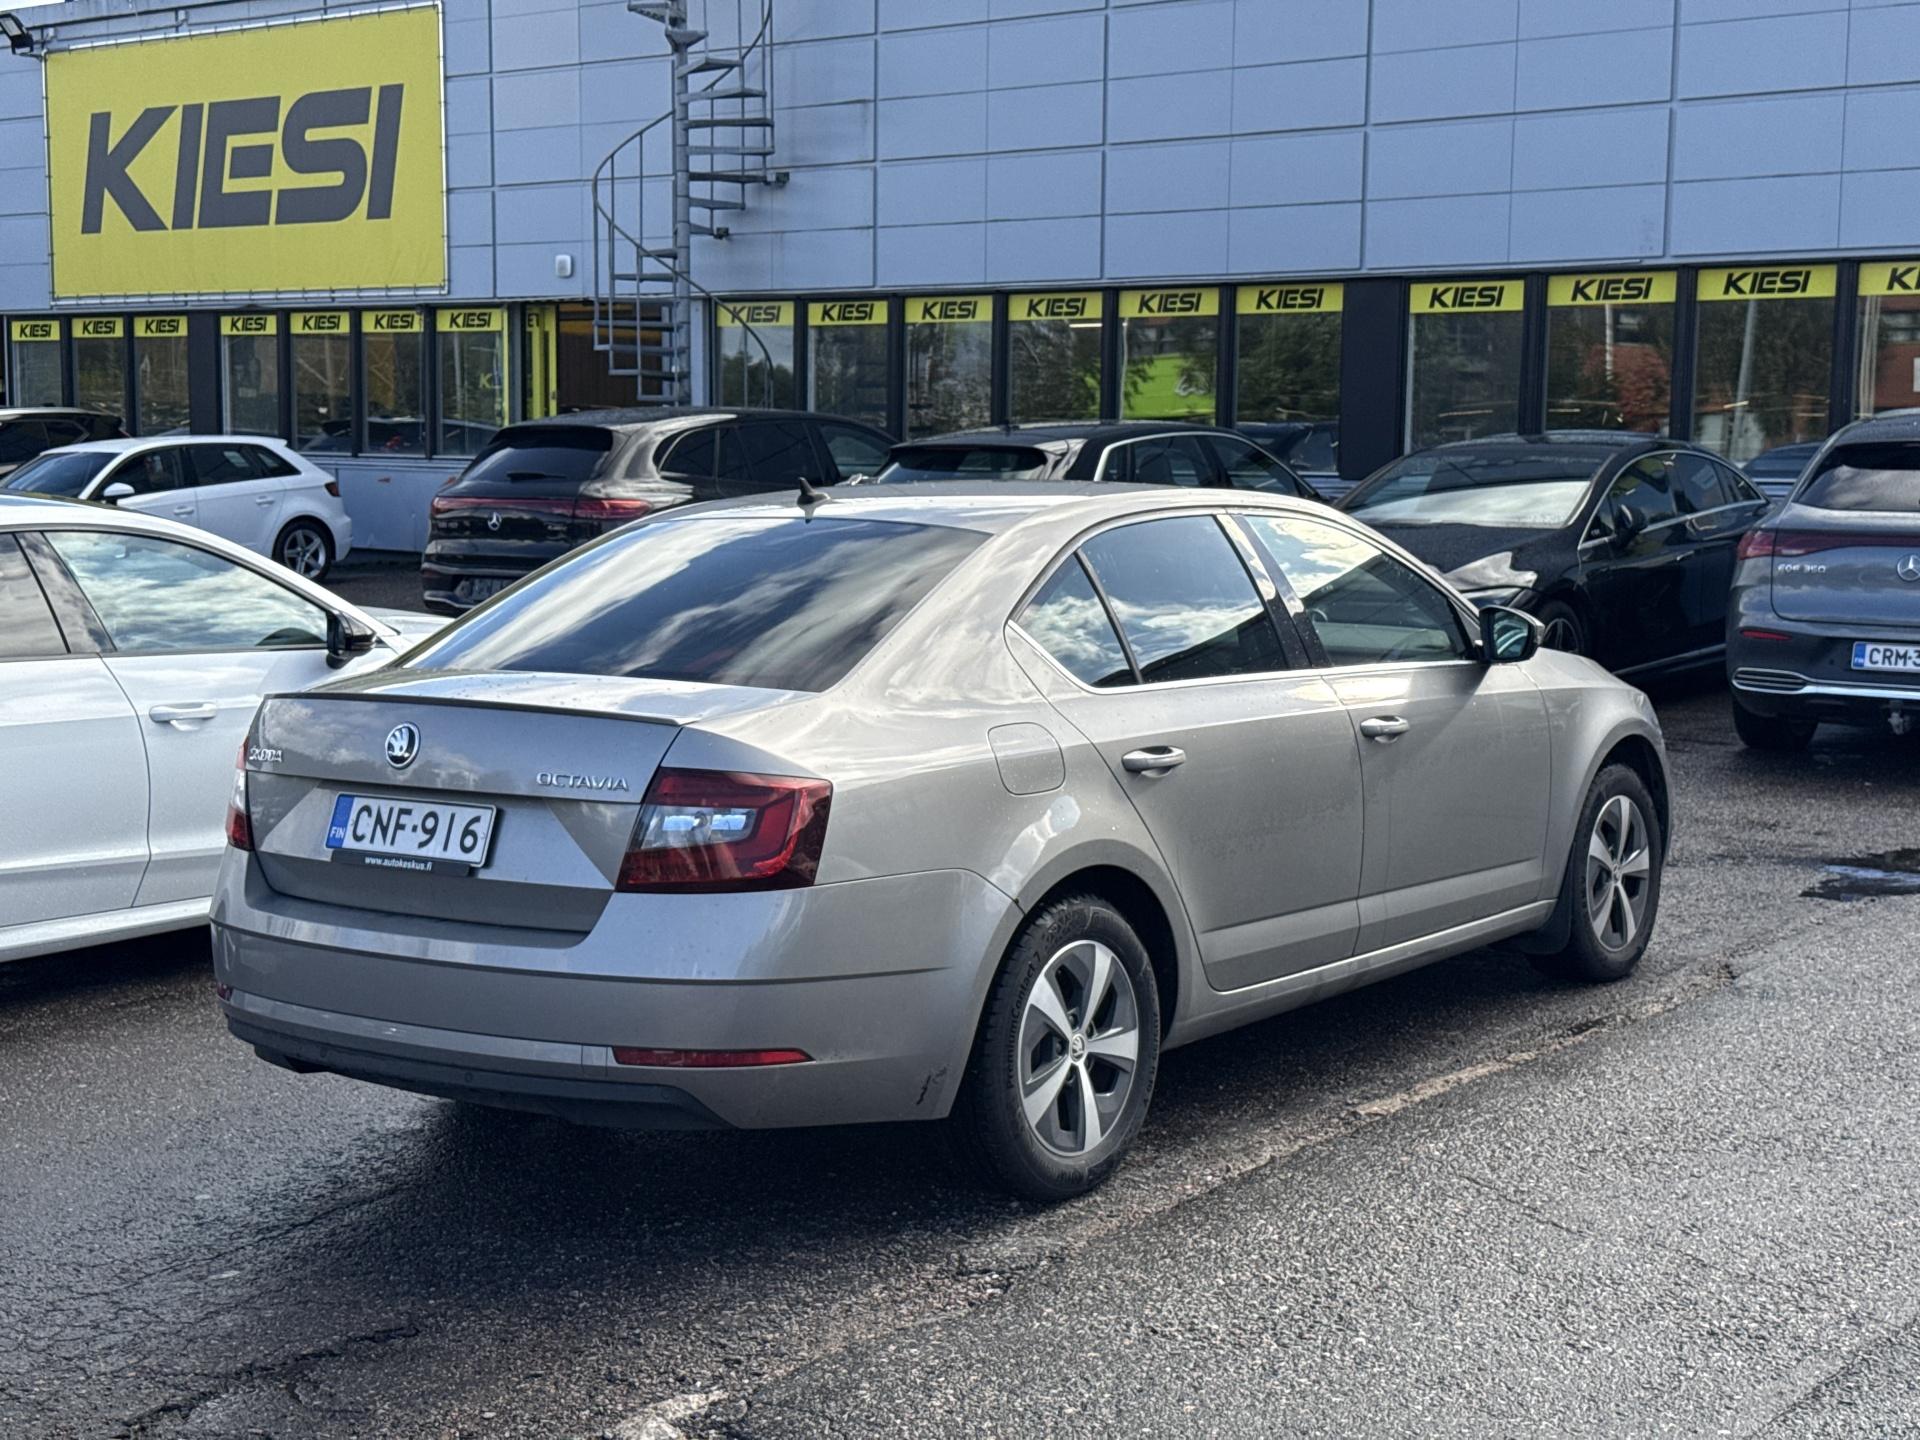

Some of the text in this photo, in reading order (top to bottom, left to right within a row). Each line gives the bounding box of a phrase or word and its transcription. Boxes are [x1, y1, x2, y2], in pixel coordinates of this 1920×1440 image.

[81, 83, 404, 235] KIESI
[1571, 277, 1654, 302] KIESI
[1723, 270, 1811, 295] KIESI
[1138, 292, 1203, 314] KIESI
[1256, 288, 1325, 310] KIESI
[1429, 286, 1505, 309] KIESI
[730, 305, 782, 324] KIESI
[821, 303, 874, 322] KIESI
[922, 301, 978, 320] KIESI
[1027, 298, 1087, 318] KIESI
[83, 320, 116, 335] KIESI
[145, 319, 180, 334] KIESI
[230, 316, 267, 332] KIESI
[302, 314, 341, 331] KIESI
[374, 313, 414, 329] KIESI
[449, 312, 492, 329] KIESI
[20, 323, 52, 338] KIESI
[536, 771, 630, 792] OCTAVIA
[329, 826, 345, 839] FIN
[352, 804, 482, 854] CNF-916
[364, 855, 433, 872] www.autokeskus.fi
